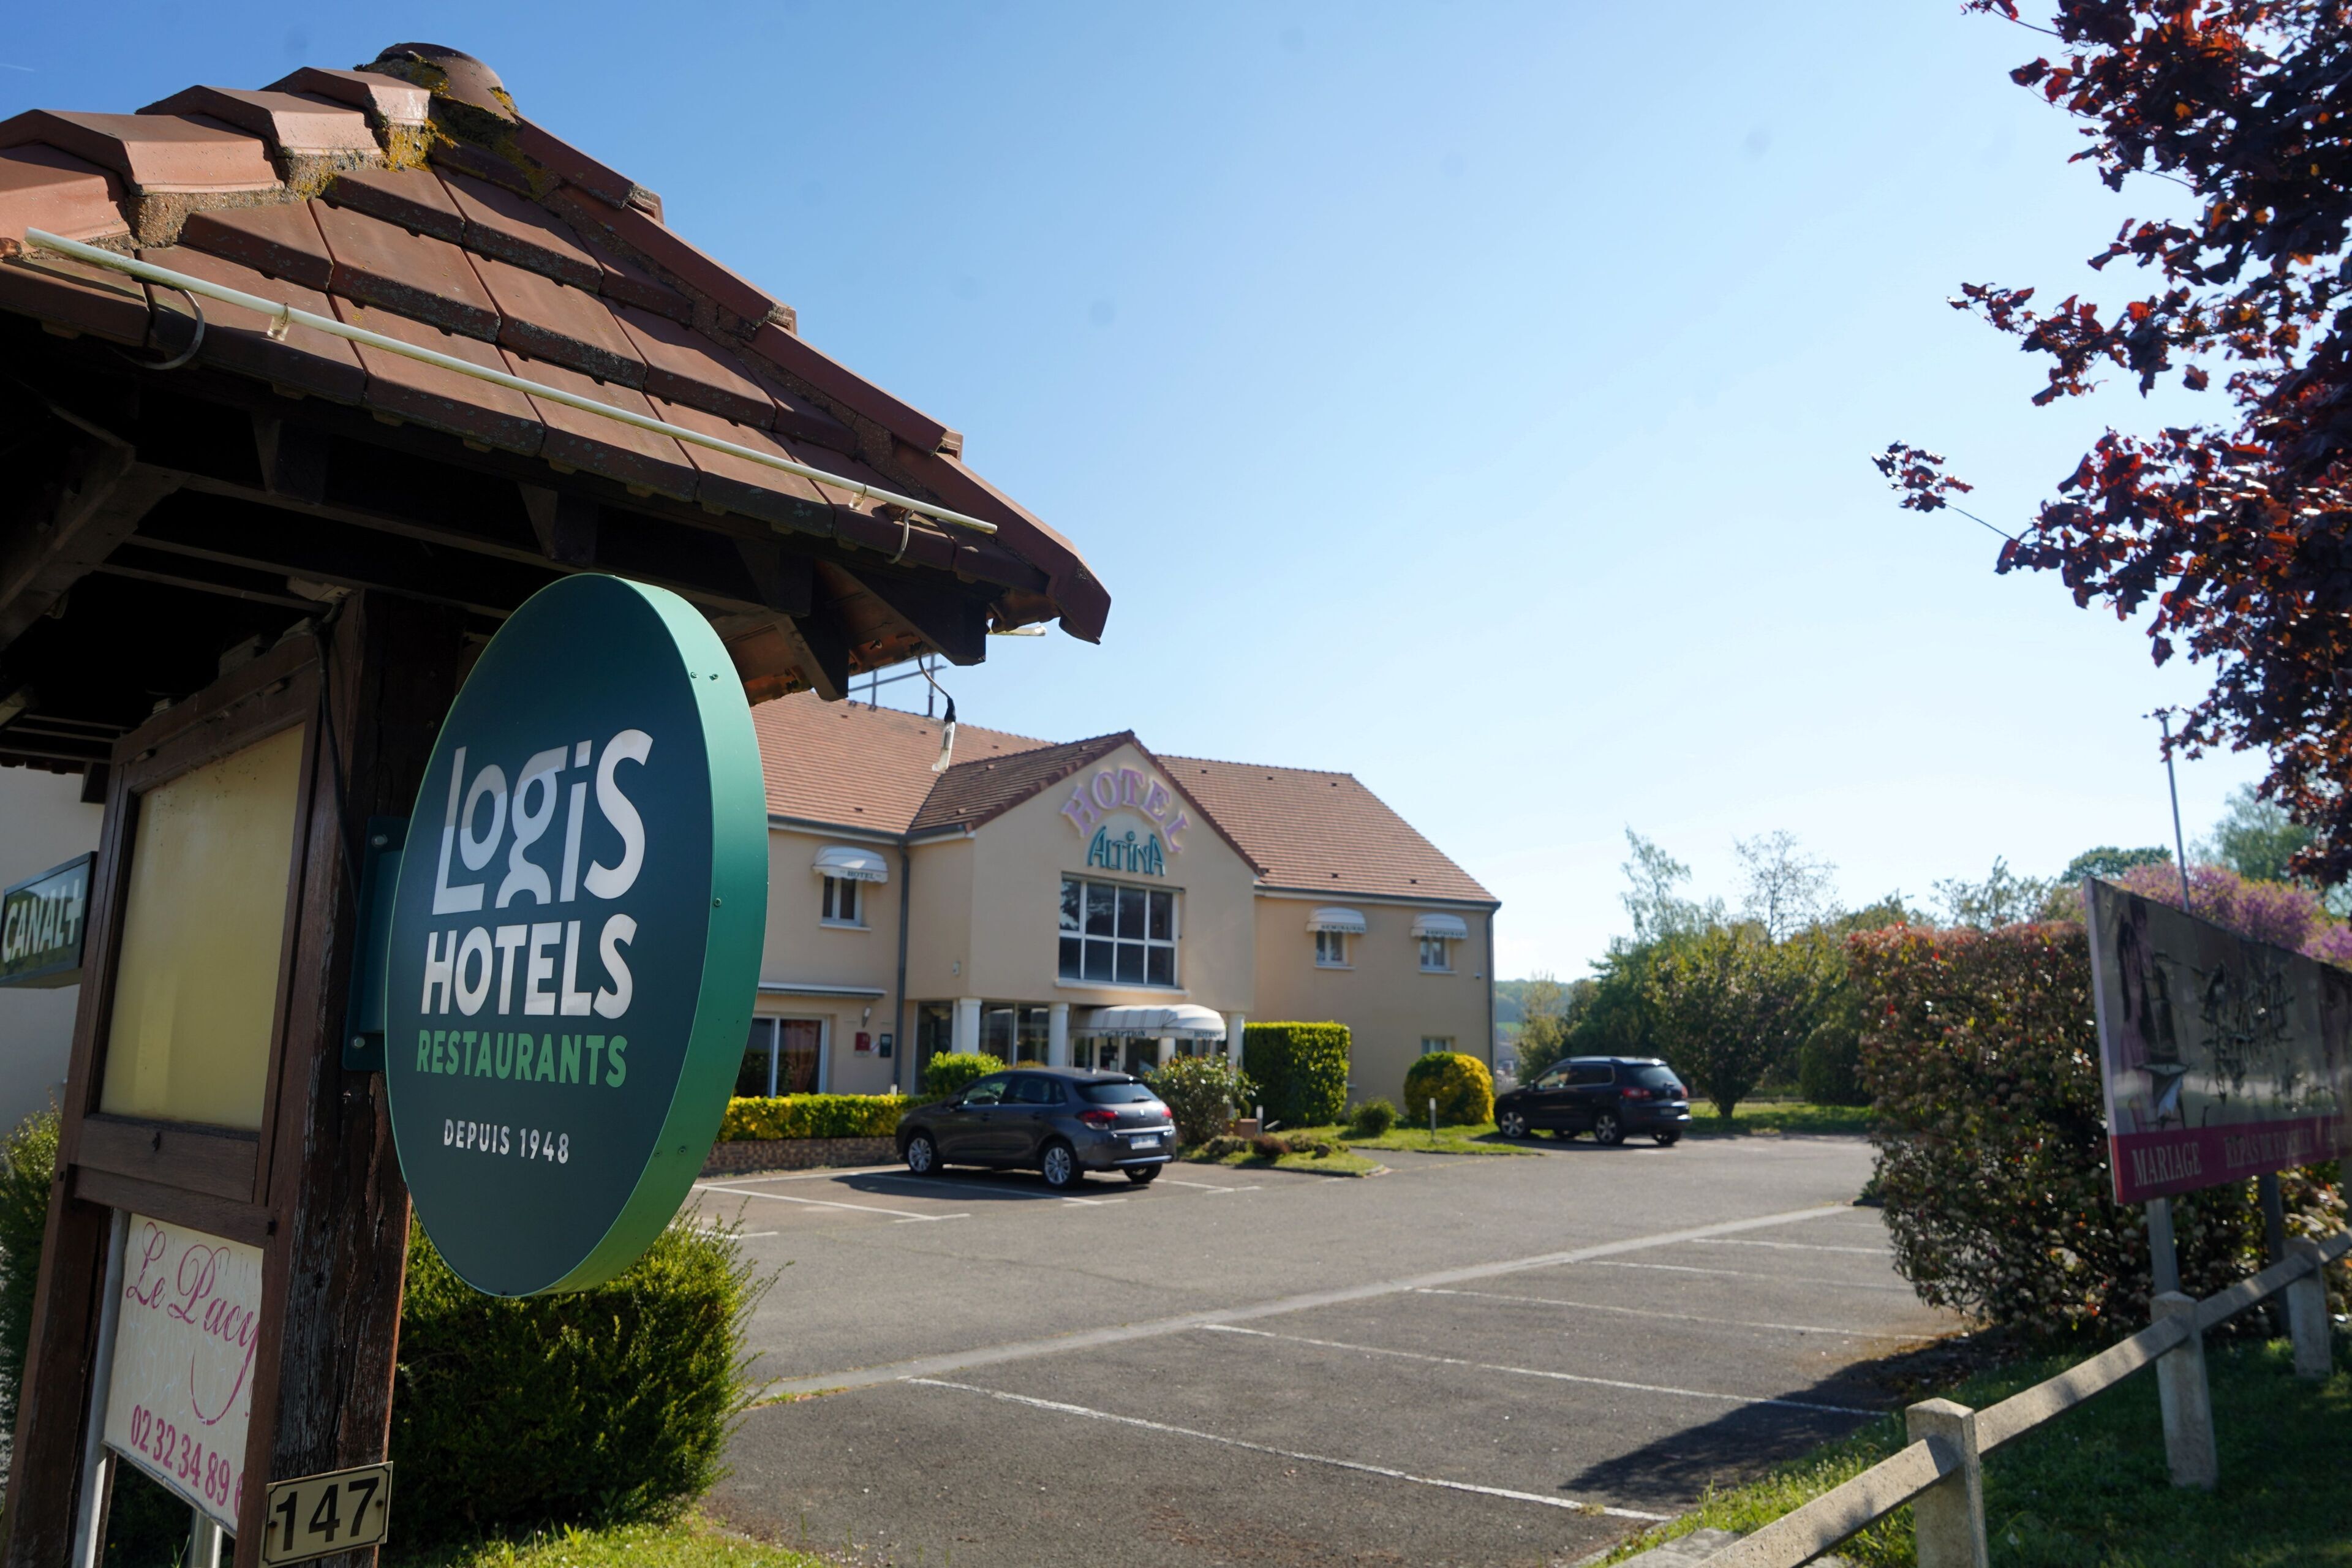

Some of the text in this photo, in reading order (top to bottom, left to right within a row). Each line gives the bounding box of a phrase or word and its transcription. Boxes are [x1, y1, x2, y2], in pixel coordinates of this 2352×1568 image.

[1060, 767, 1189, 854] HOTEL
[847, 870, 876, 880] HOTEL
[2, 878, 83, 963] CANAL+
[421, 913, 638, 1020] HOTELS
[416, 1030, 628, 1088] RESTAURANTS
[443, 1118, 571, 1165] DEPUIS 1948
[2131, 1141, 2203, 1188] MARIAGE
[126, 1221, 166, 1310] Le
[130, 1404, 151, 1454] 02
[153, 1418, 176, 1470] 32
[178, 1434, 202, 1489] 34
[204, 1452, 231, 1507] 89
[275, 1476, 380, 1552] 147
